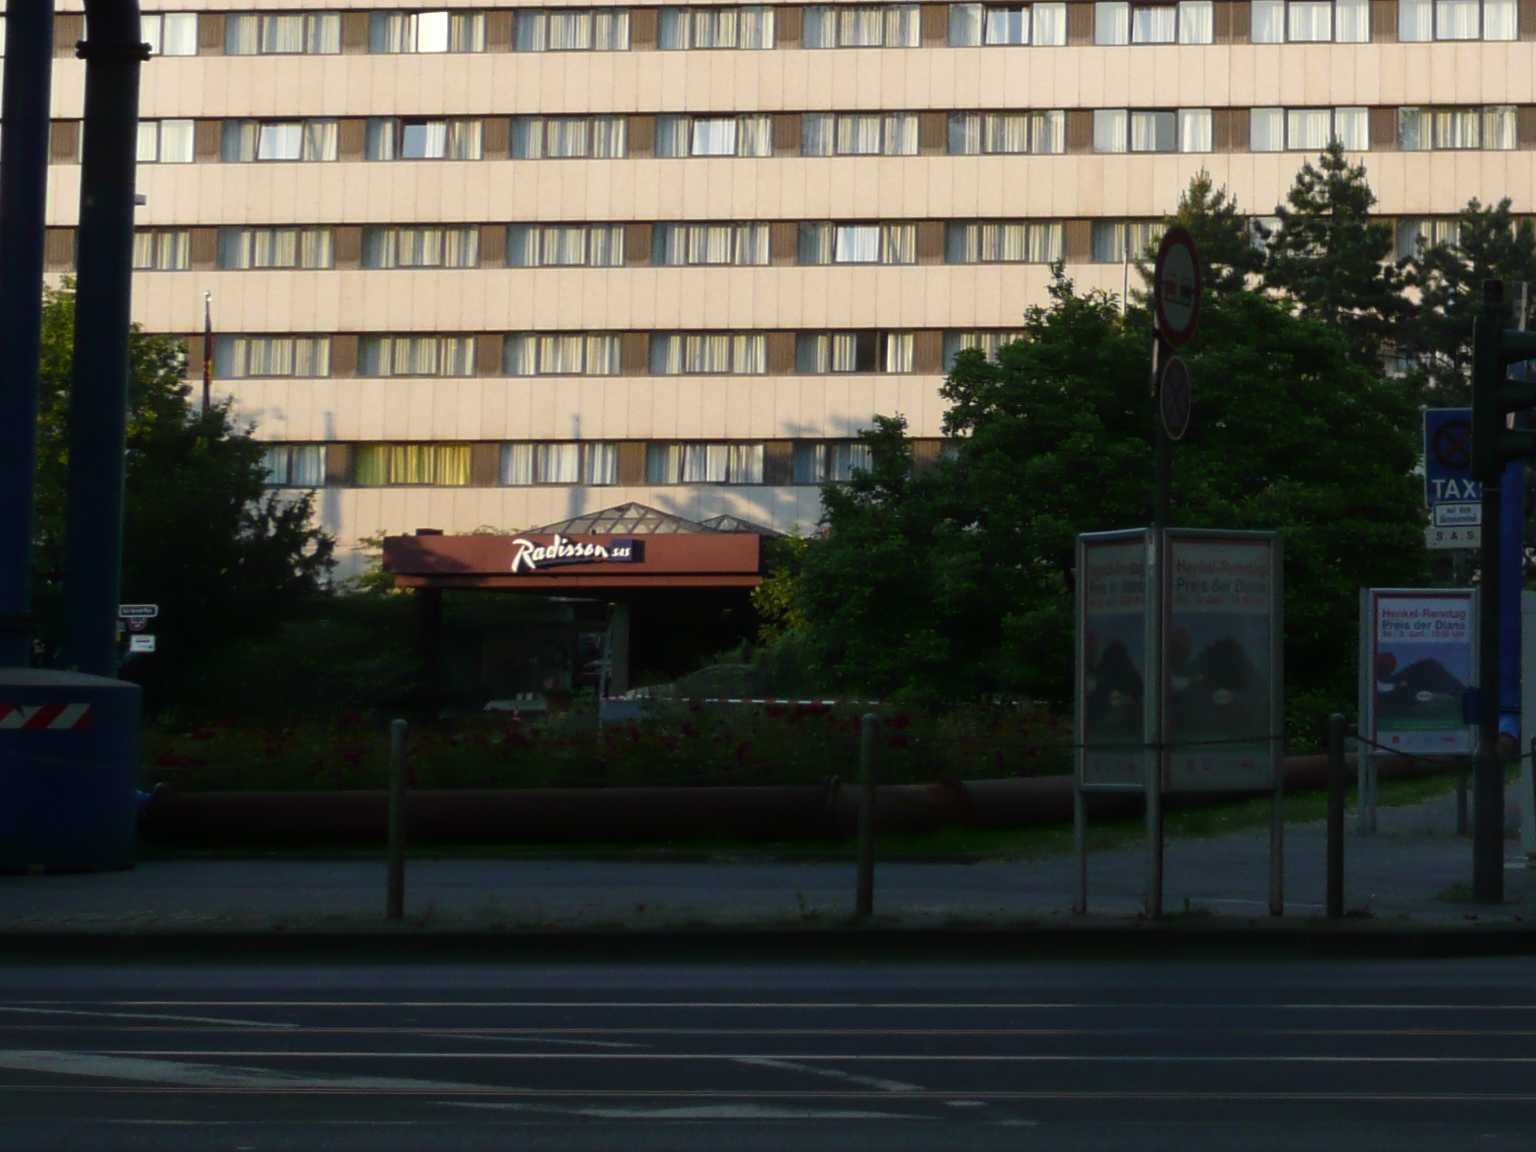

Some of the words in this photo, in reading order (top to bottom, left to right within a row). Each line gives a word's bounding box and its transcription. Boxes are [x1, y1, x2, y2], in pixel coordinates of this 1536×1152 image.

[511, 534, 609, 573] Radisson
[611, 547, 631, 557] SAS
[1382, 620, 1410, 630] Preis
[1413, 620, 1431, 630] der
[1435, 620, 1466, 630] Diana
